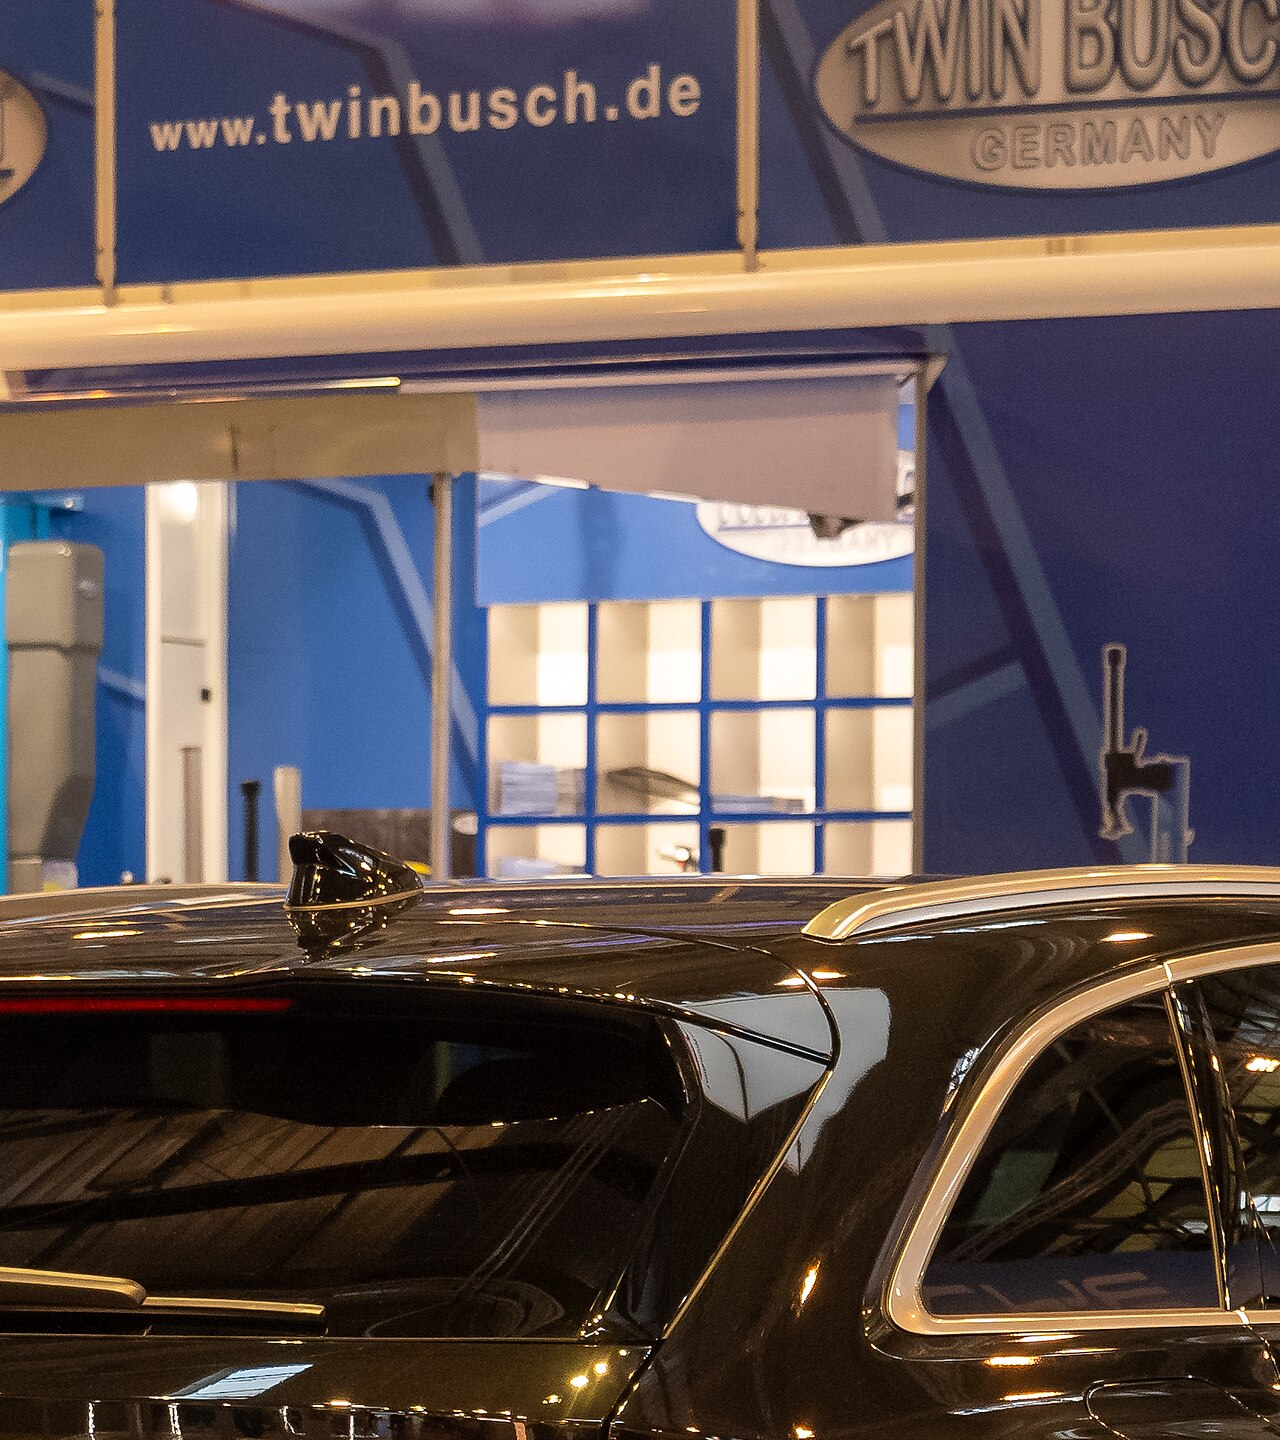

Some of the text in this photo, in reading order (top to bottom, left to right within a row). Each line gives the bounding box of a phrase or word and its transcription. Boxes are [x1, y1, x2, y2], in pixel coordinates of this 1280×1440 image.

[847, 0, 1041, 108] TWIN
[150, 64, 701, 152] www.twinbusch.de
[970, 114, 1226, 171] GERMANY
